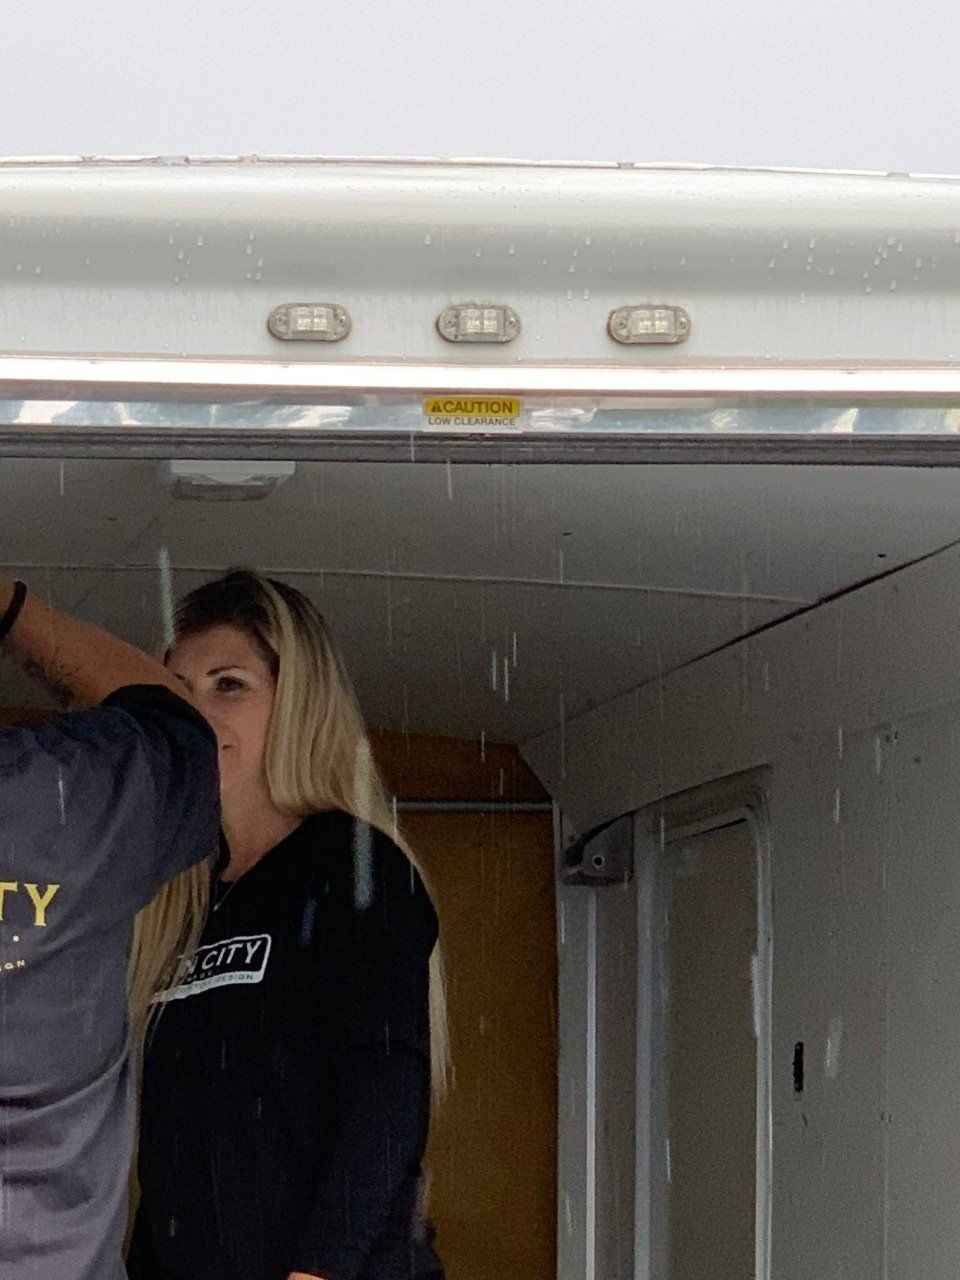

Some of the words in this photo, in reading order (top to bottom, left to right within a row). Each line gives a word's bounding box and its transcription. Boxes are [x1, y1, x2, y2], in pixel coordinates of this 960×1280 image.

[443, 400, 513, 414] CAUTION
[428, 417, 451, 426] LOW
[454, 417, 516, 426] CLEARANCE
[201, 940, 262, 970] CITY
